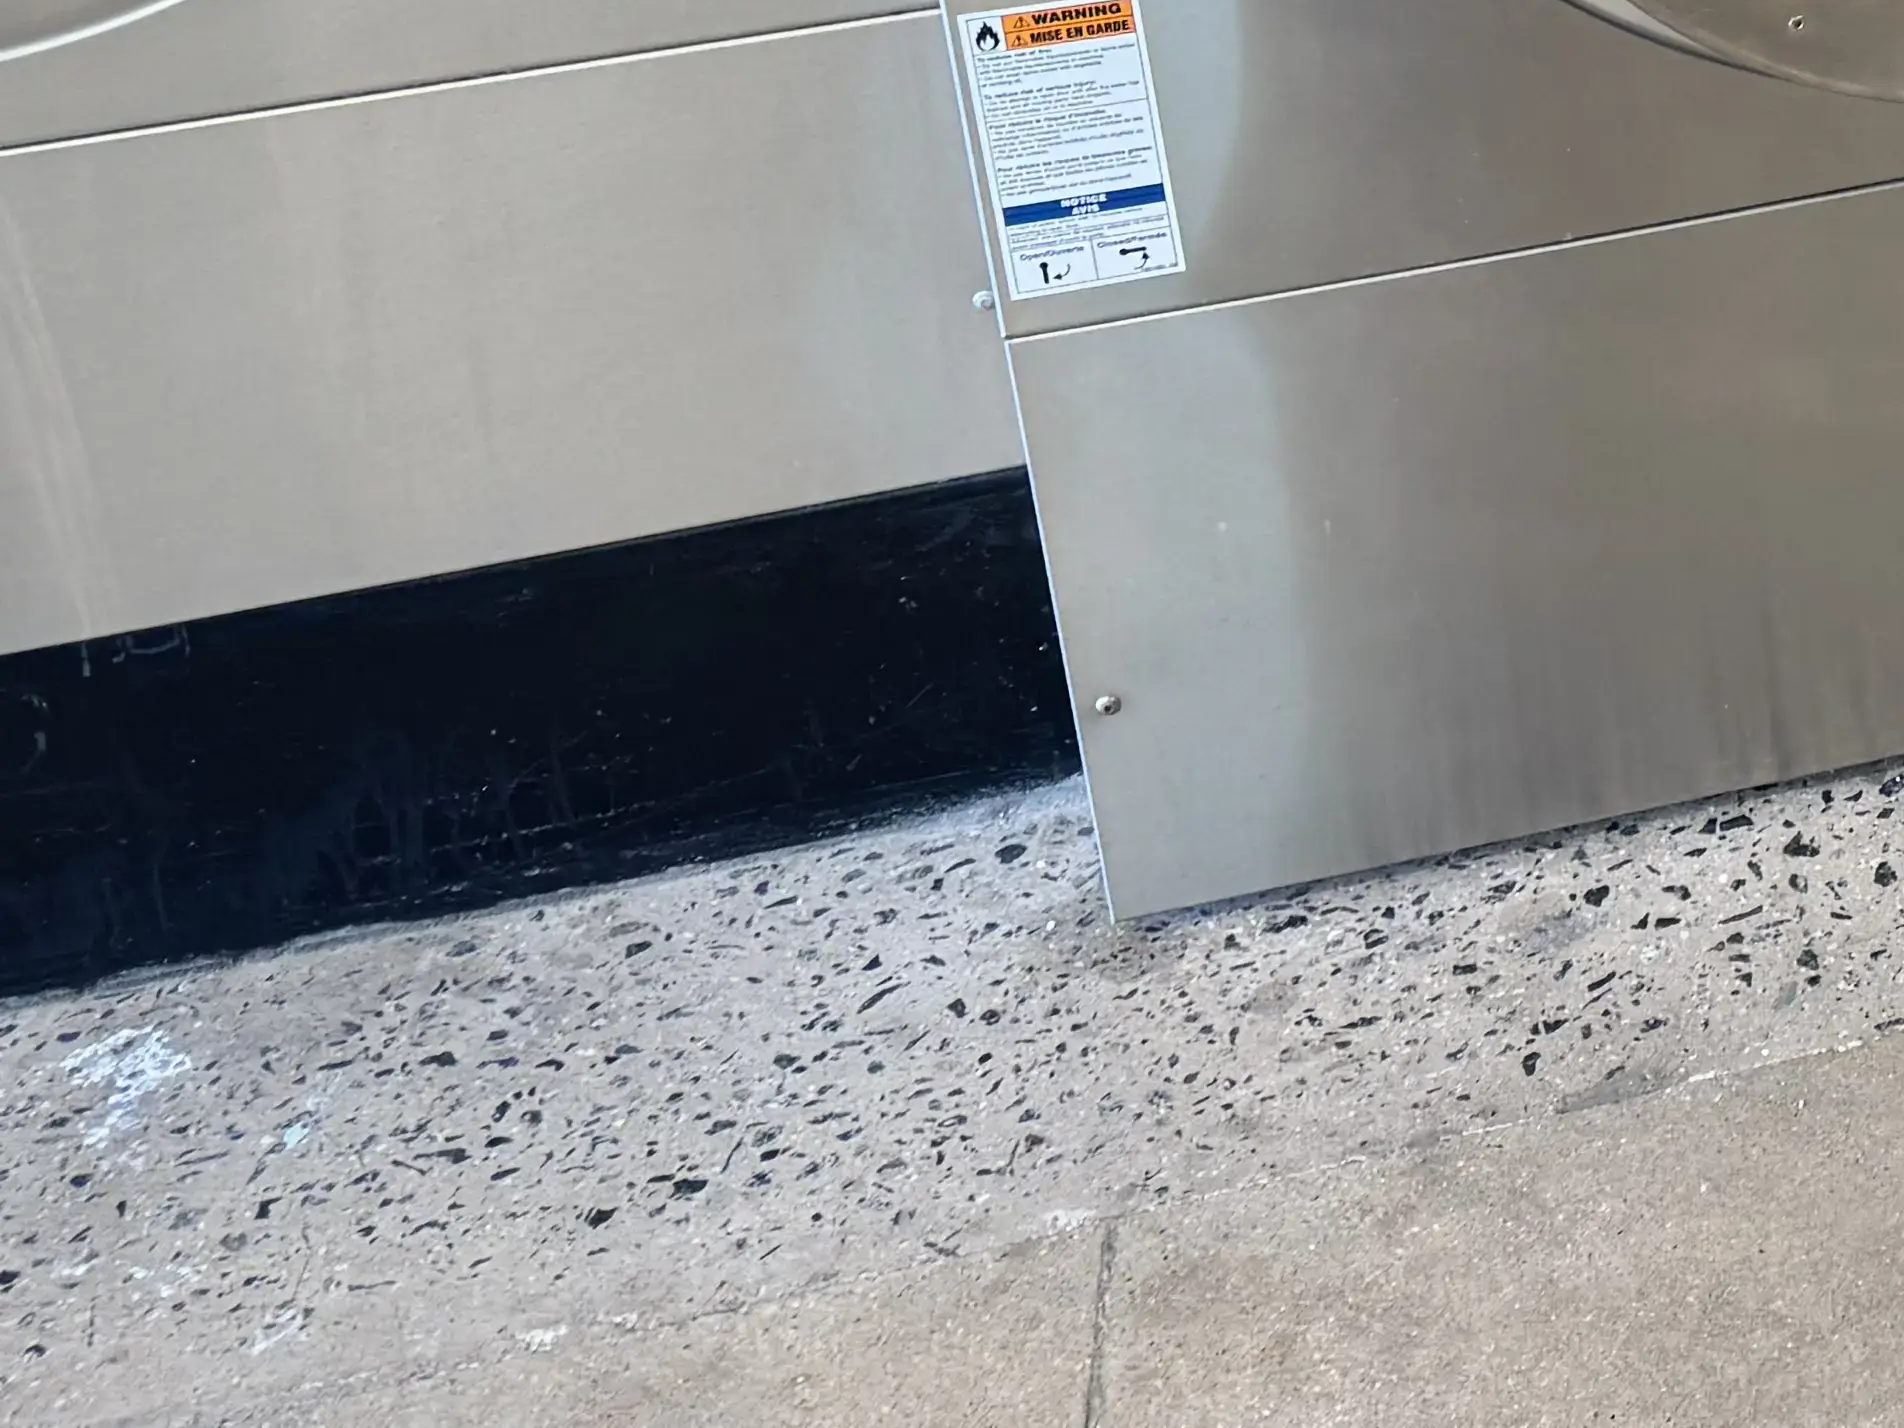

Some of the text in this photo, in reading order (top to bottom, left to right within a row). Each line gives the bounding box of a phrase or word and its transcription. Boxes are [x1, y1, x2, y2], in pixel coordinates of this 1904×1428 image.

[1032, 3, 1122, 26] WARNING
[1030, 19, 1130, 44] MISE EN GARDE
